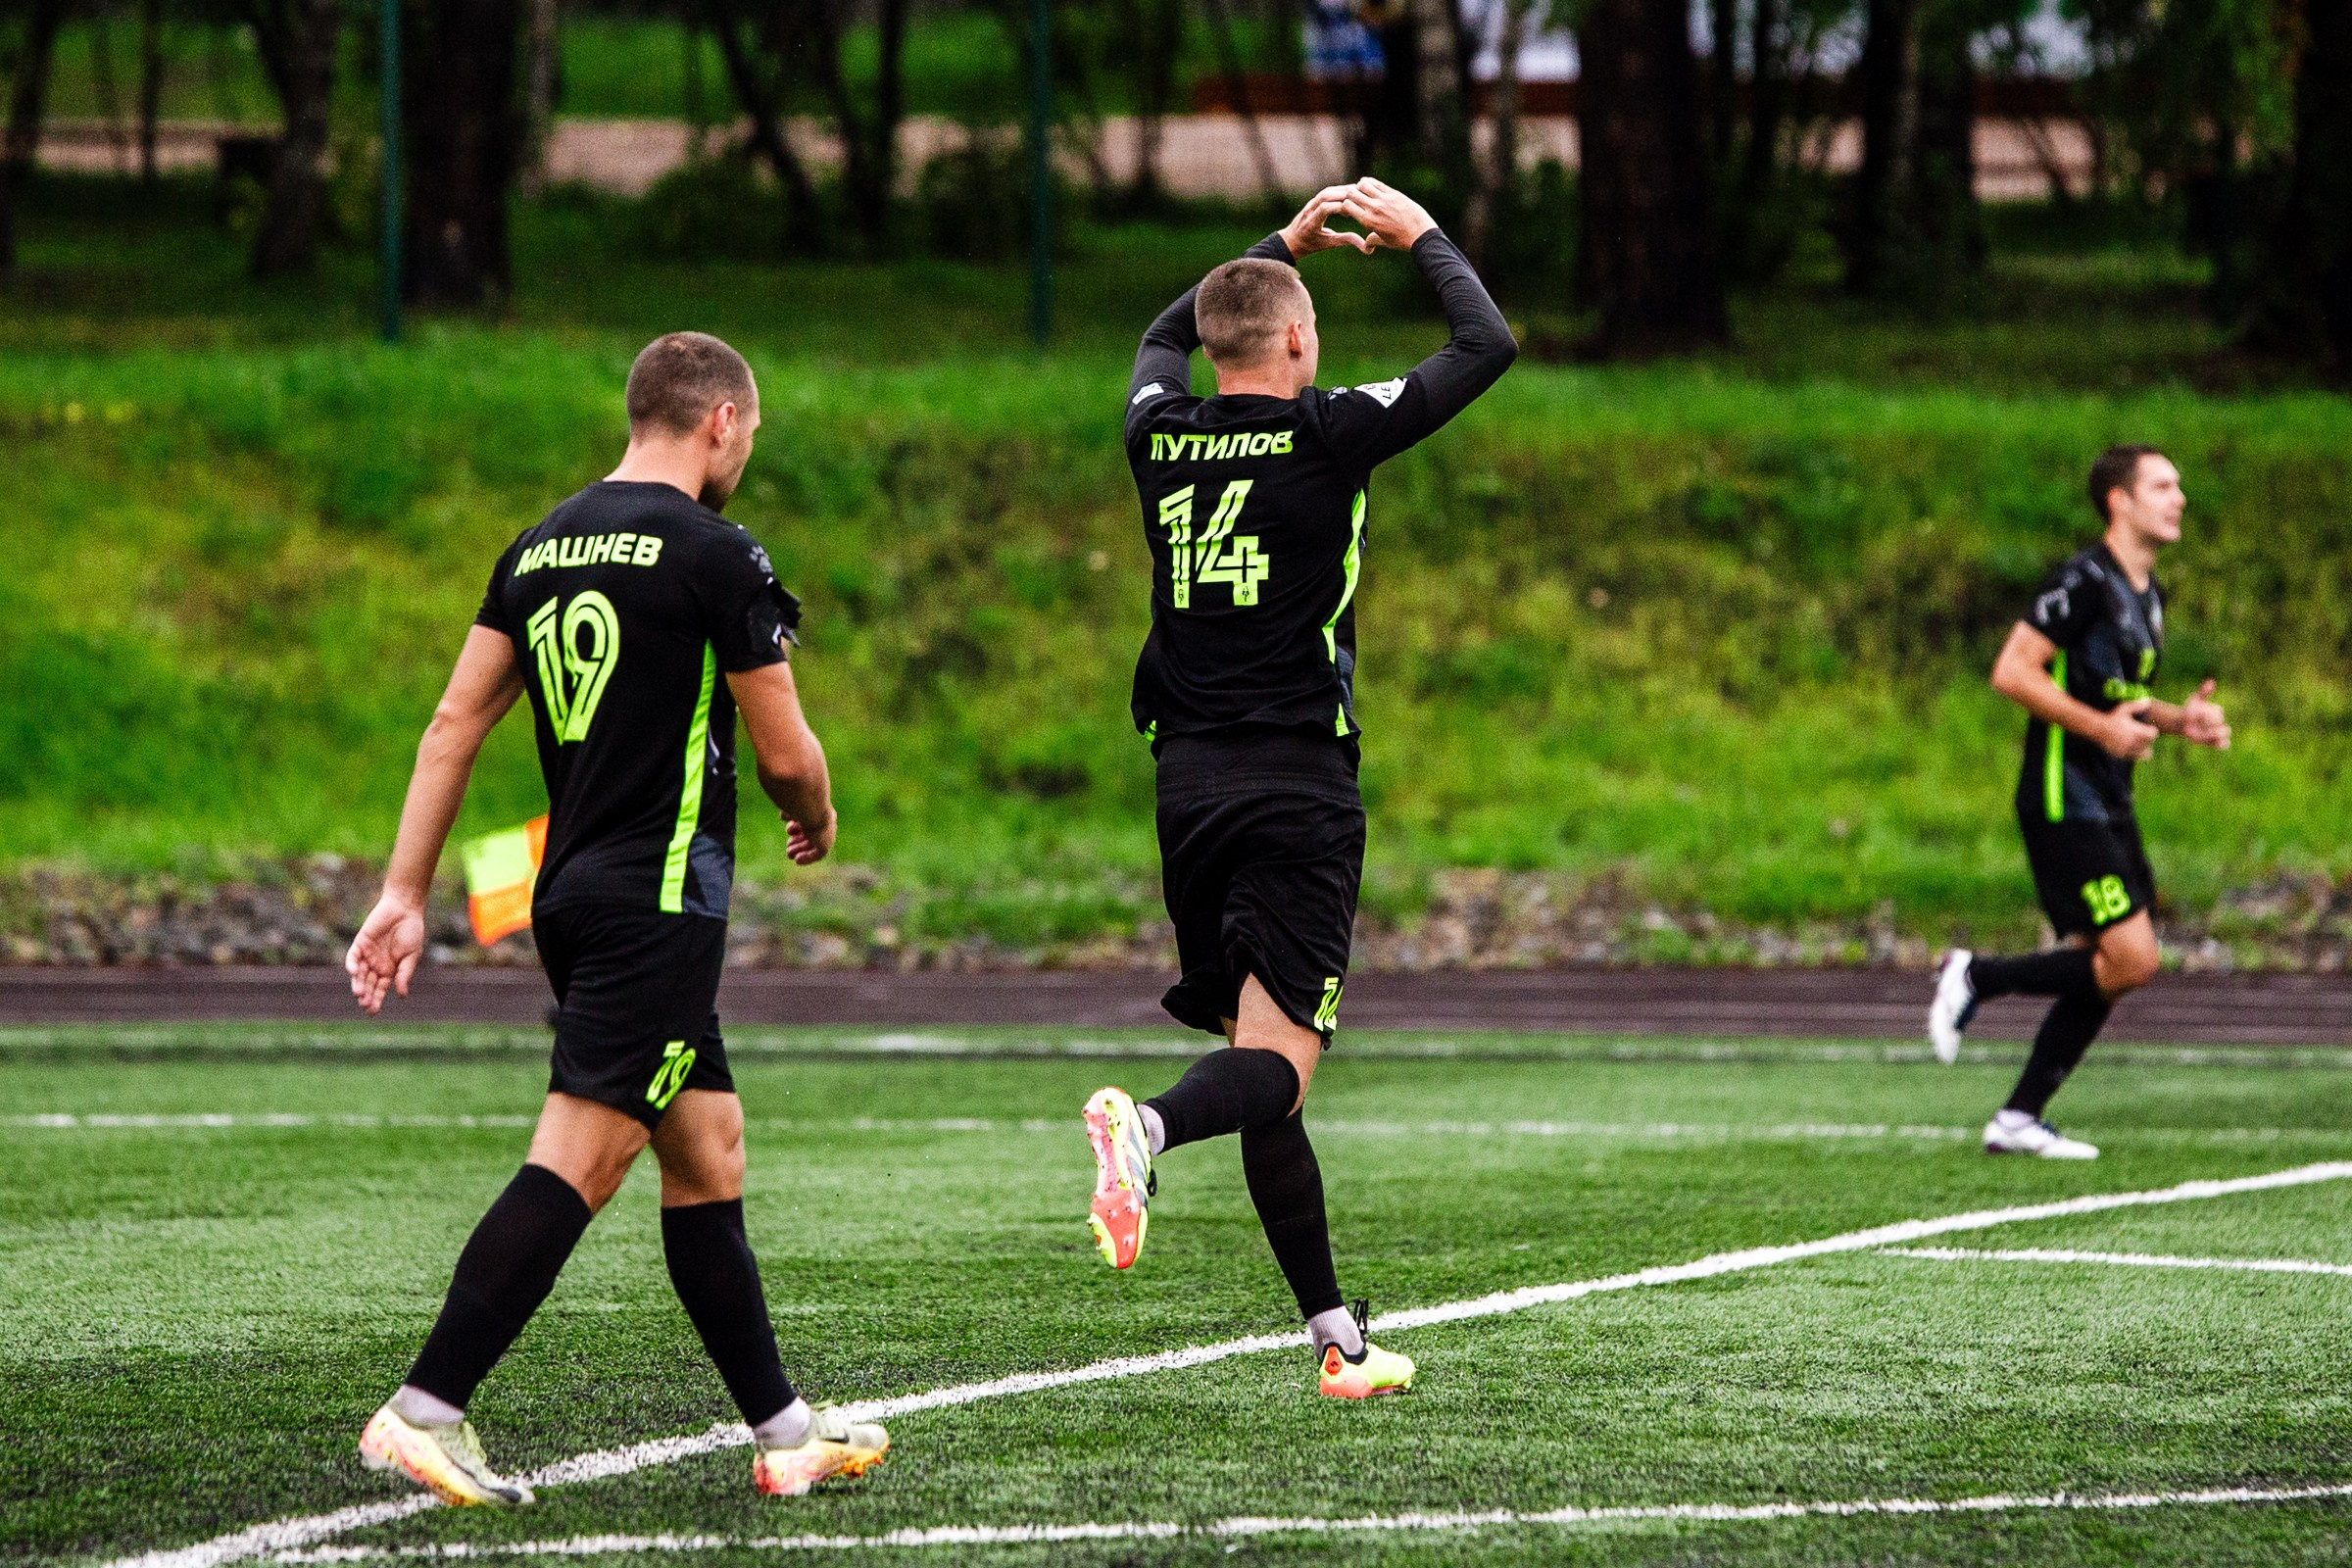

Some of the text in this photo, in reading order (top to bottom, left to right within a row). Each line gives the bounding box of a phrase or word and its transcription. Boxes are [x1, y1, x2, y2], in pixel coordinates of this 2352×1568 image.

[1151, 430, 1294, 461] ПУТИЛОВ
[514, 532, 663, 576] МАШНЕВ
[1158, 479, 1270, 609] 14
[526, 590, 620, 746] 19
[2082, 875, 2131, 926] 18
[645, 1040, 697, 1111] 19
